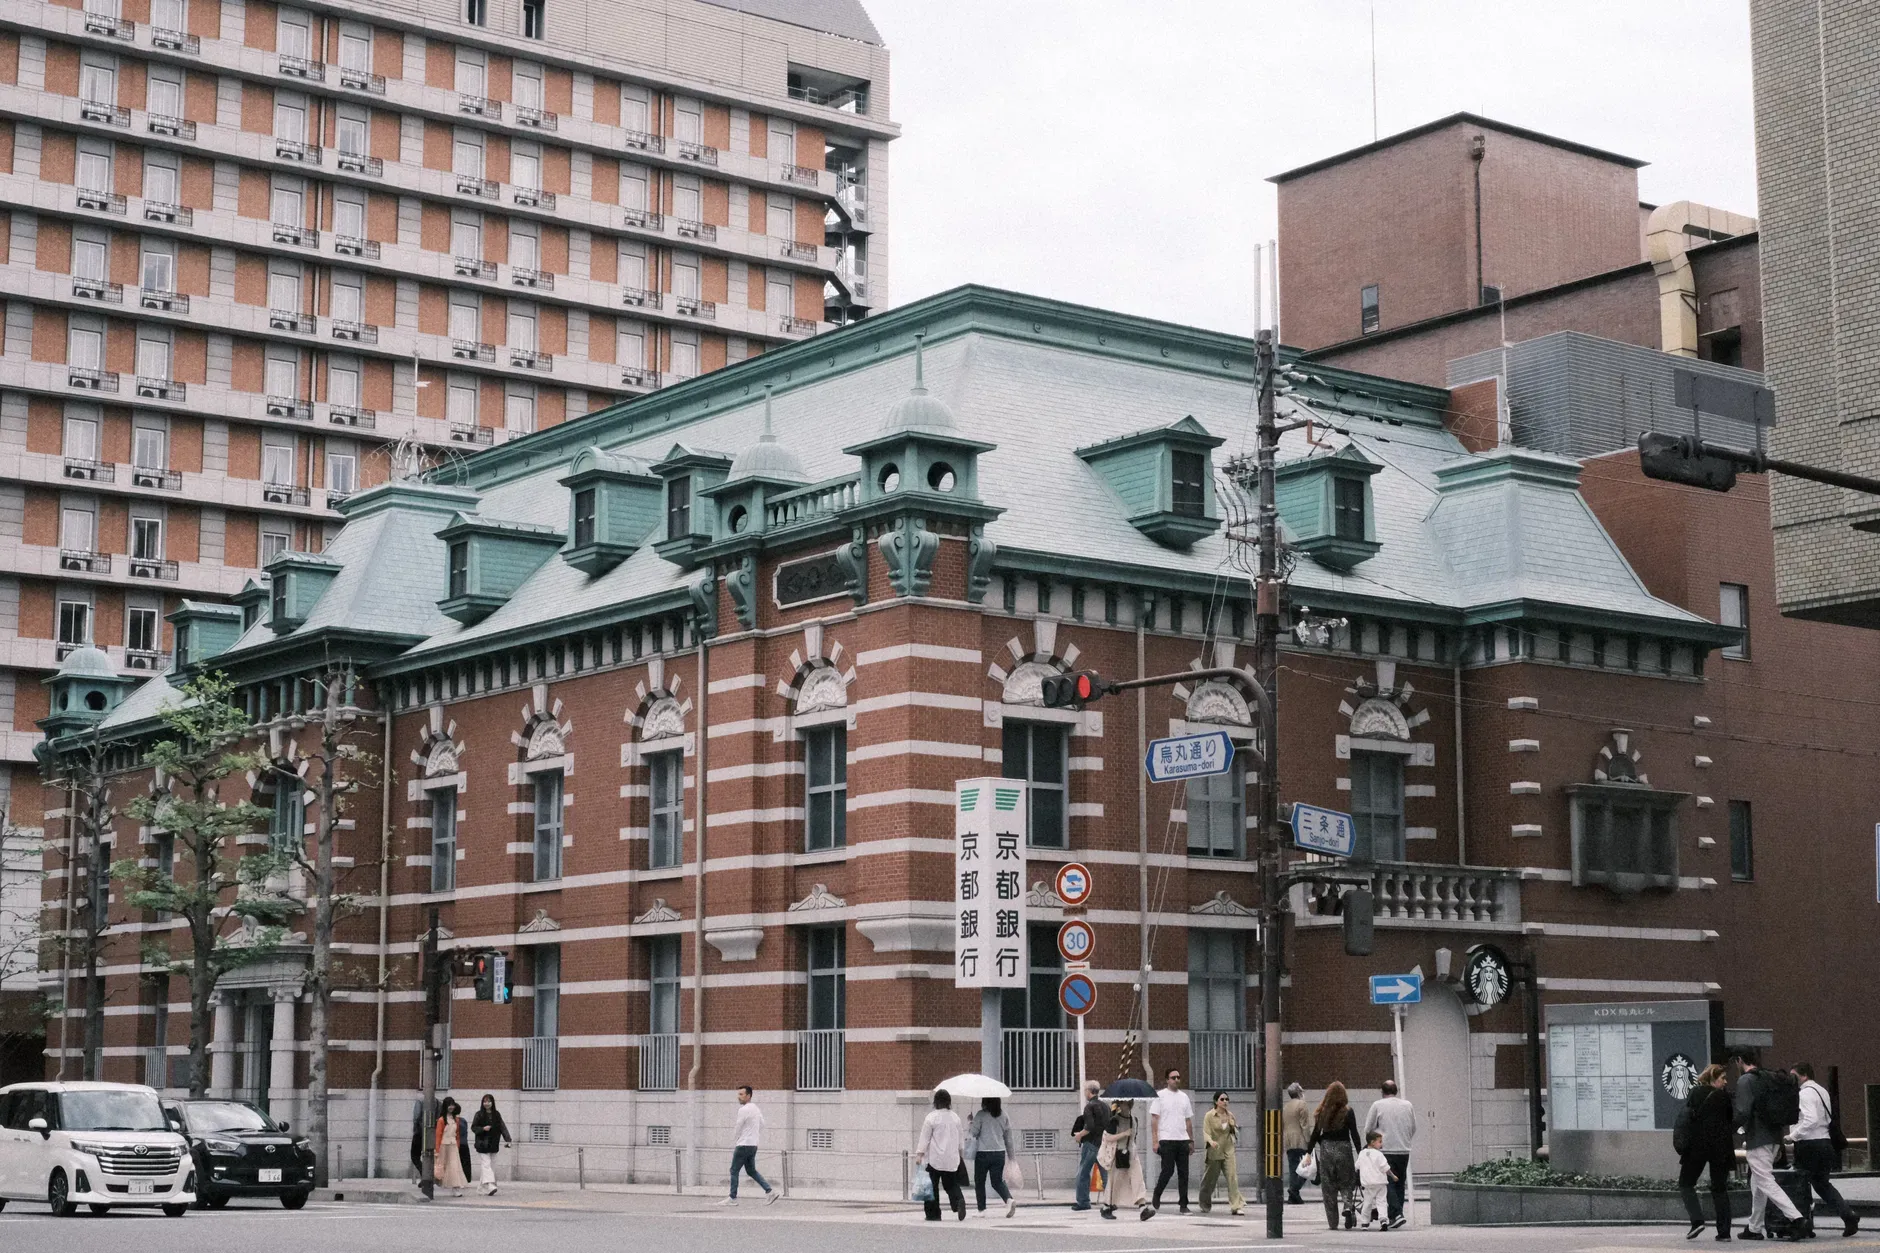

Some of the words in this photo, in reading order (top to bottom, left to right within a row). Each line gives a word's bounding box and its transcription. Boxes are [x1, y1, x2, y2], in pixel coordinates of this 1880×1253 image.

[1161, 738, 1217, 764] 烏丸通り
[1164, 759, 1215, 775] Karasuma-dori
[1303, 811, 1345, 838] 三条通
[1309, 832, 1340, 848] Sanjo-dori
[960, 831, 980, 978] 京都銀行
[995, 830, 1020, 978] 京都銀行
[1066, 932, 1087, 950] 30
[1594, 1008, 1617, 1016] KDX
